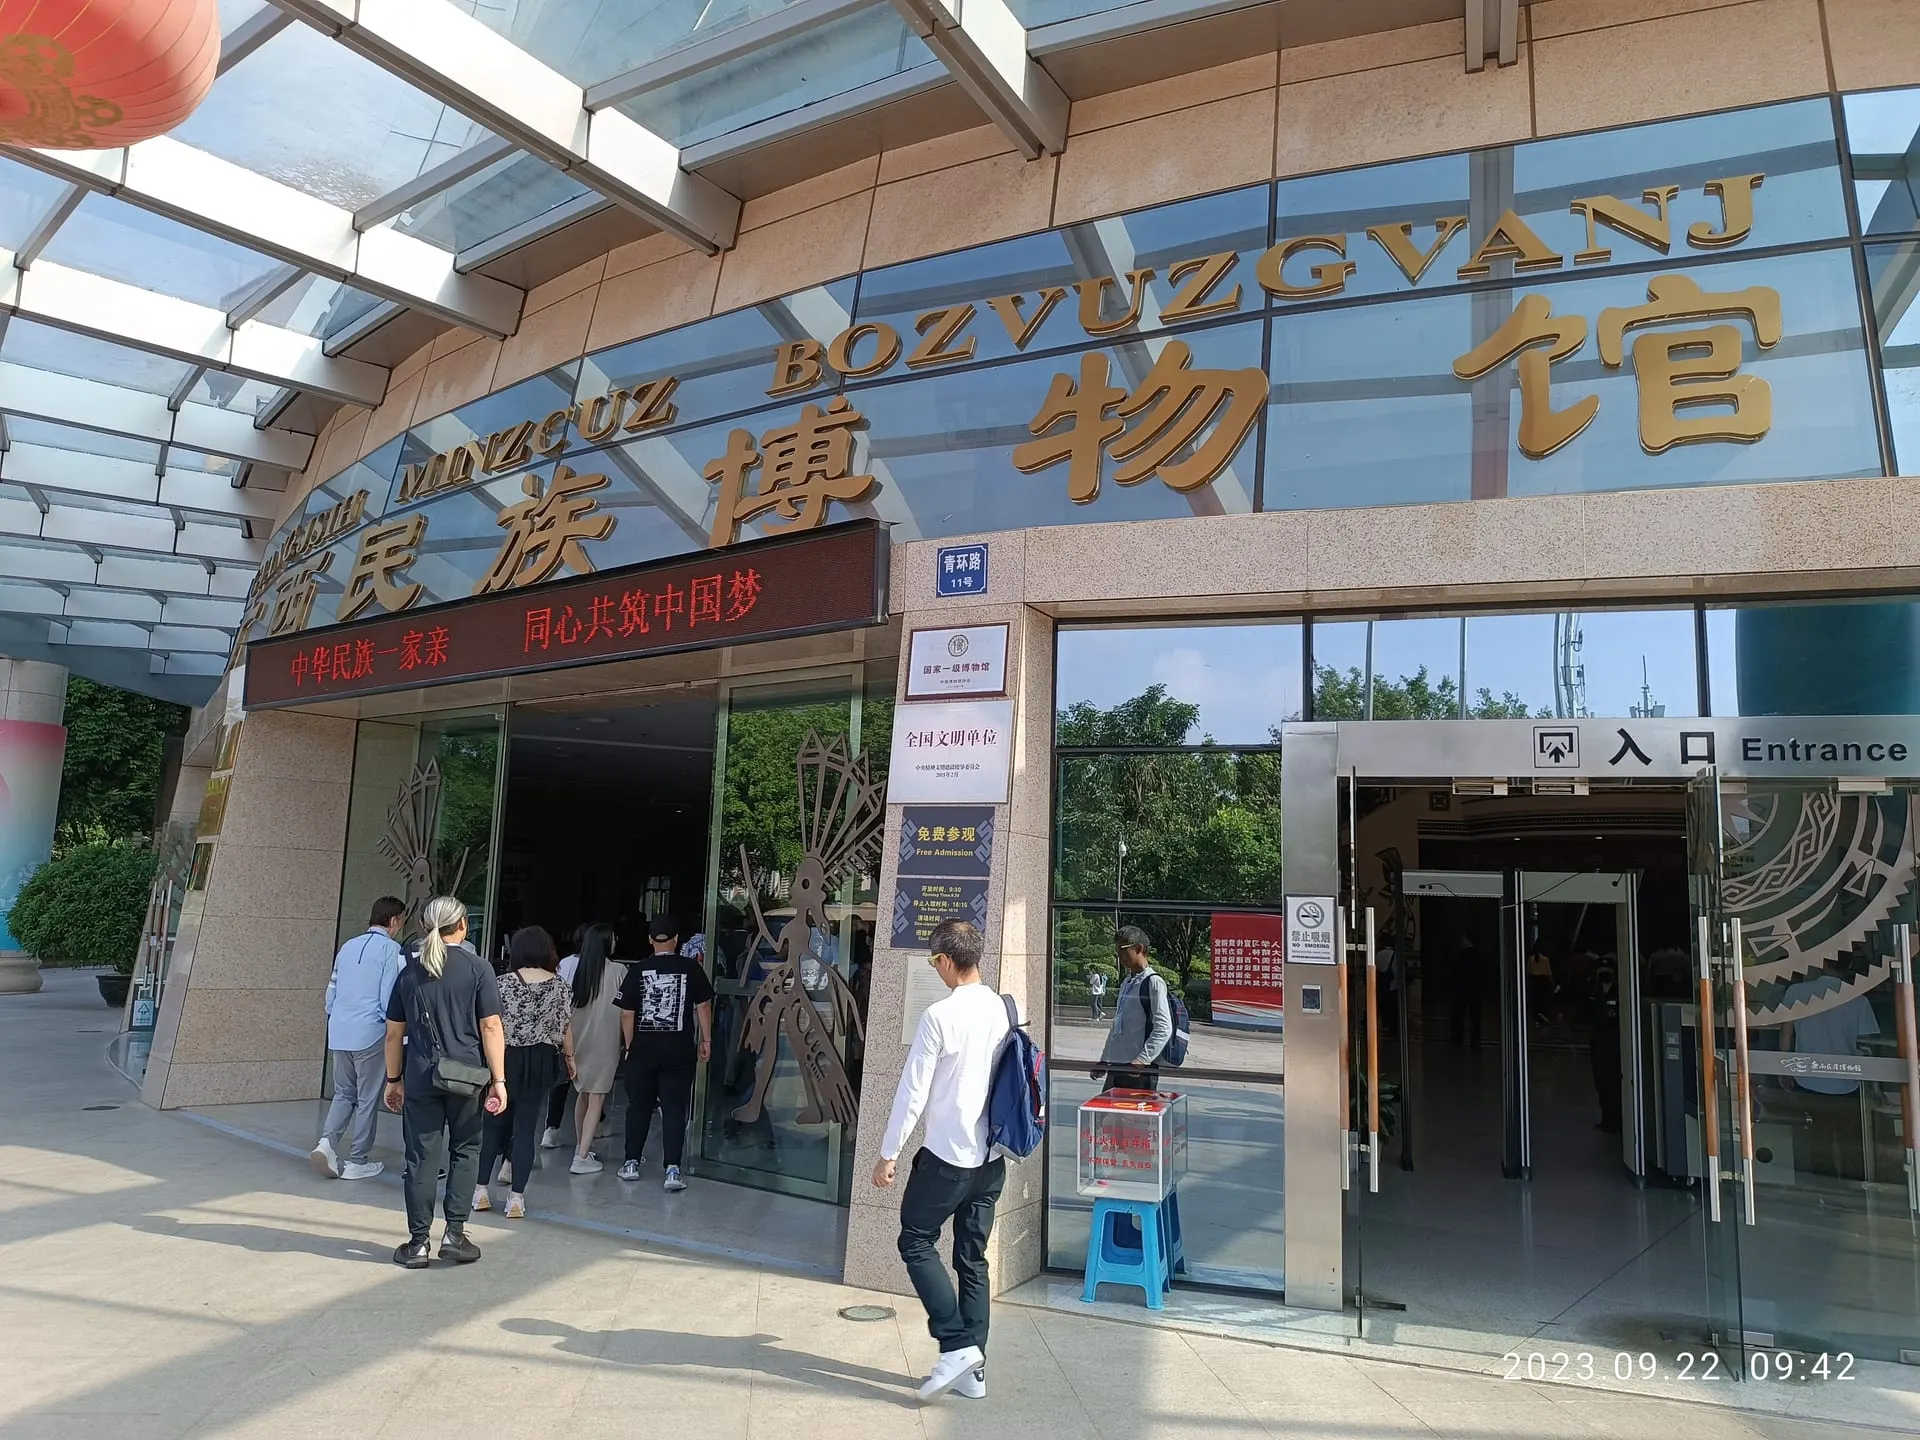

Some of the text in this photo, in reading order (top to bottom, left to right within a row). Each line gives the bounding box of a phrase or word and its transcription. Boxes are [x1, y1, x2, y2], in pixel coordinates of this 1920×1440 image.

[764, 172, 1766, 399] BOZVUZGVANJ
[943, 552, 981, 574] 青环路
[951, 576, 974, 589] 11号
[290, 566, 764, 688] 中华民族一家亲 同心共筑中国梦
[923, 661, 991, 675] 国家一级博物馆
[904, 729, 998, 748] 全国文明单位
[1608, 727, 1908, 766] 入口 Entrance
[917, 826, 976, 842] 免费参观
[916, 848, 974, 857] Free Admission
[1291, 930, 1331, 943] 禁止吸烟
